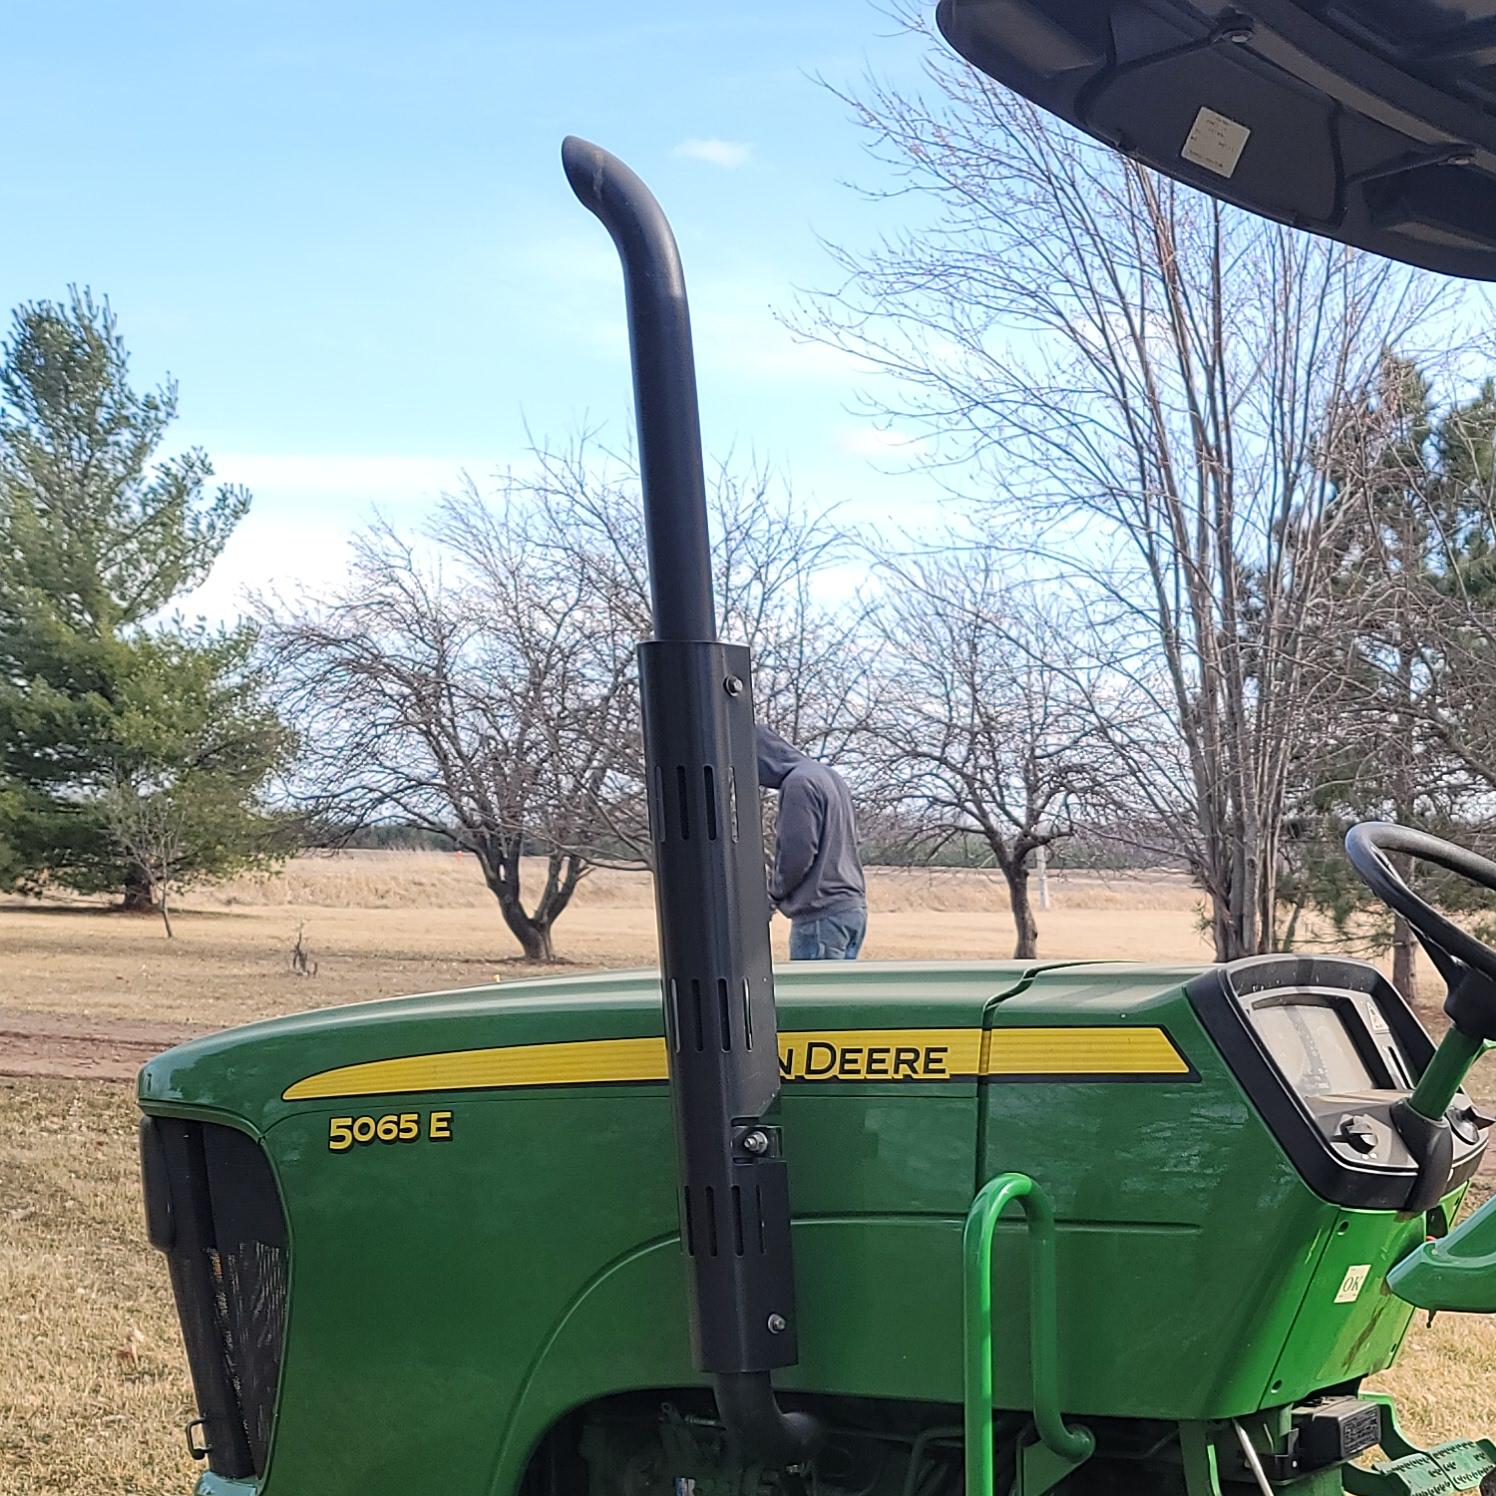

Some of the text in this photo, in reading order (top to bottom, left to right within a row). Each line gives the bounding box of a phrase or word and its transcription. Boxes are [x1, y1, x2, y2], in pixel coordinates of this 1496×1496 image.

[805, 1041, 949, 1077] DEERE
[328, 1111, 453, 1152] 5065 E
[1343, 1276, 1363, 1292] OK
